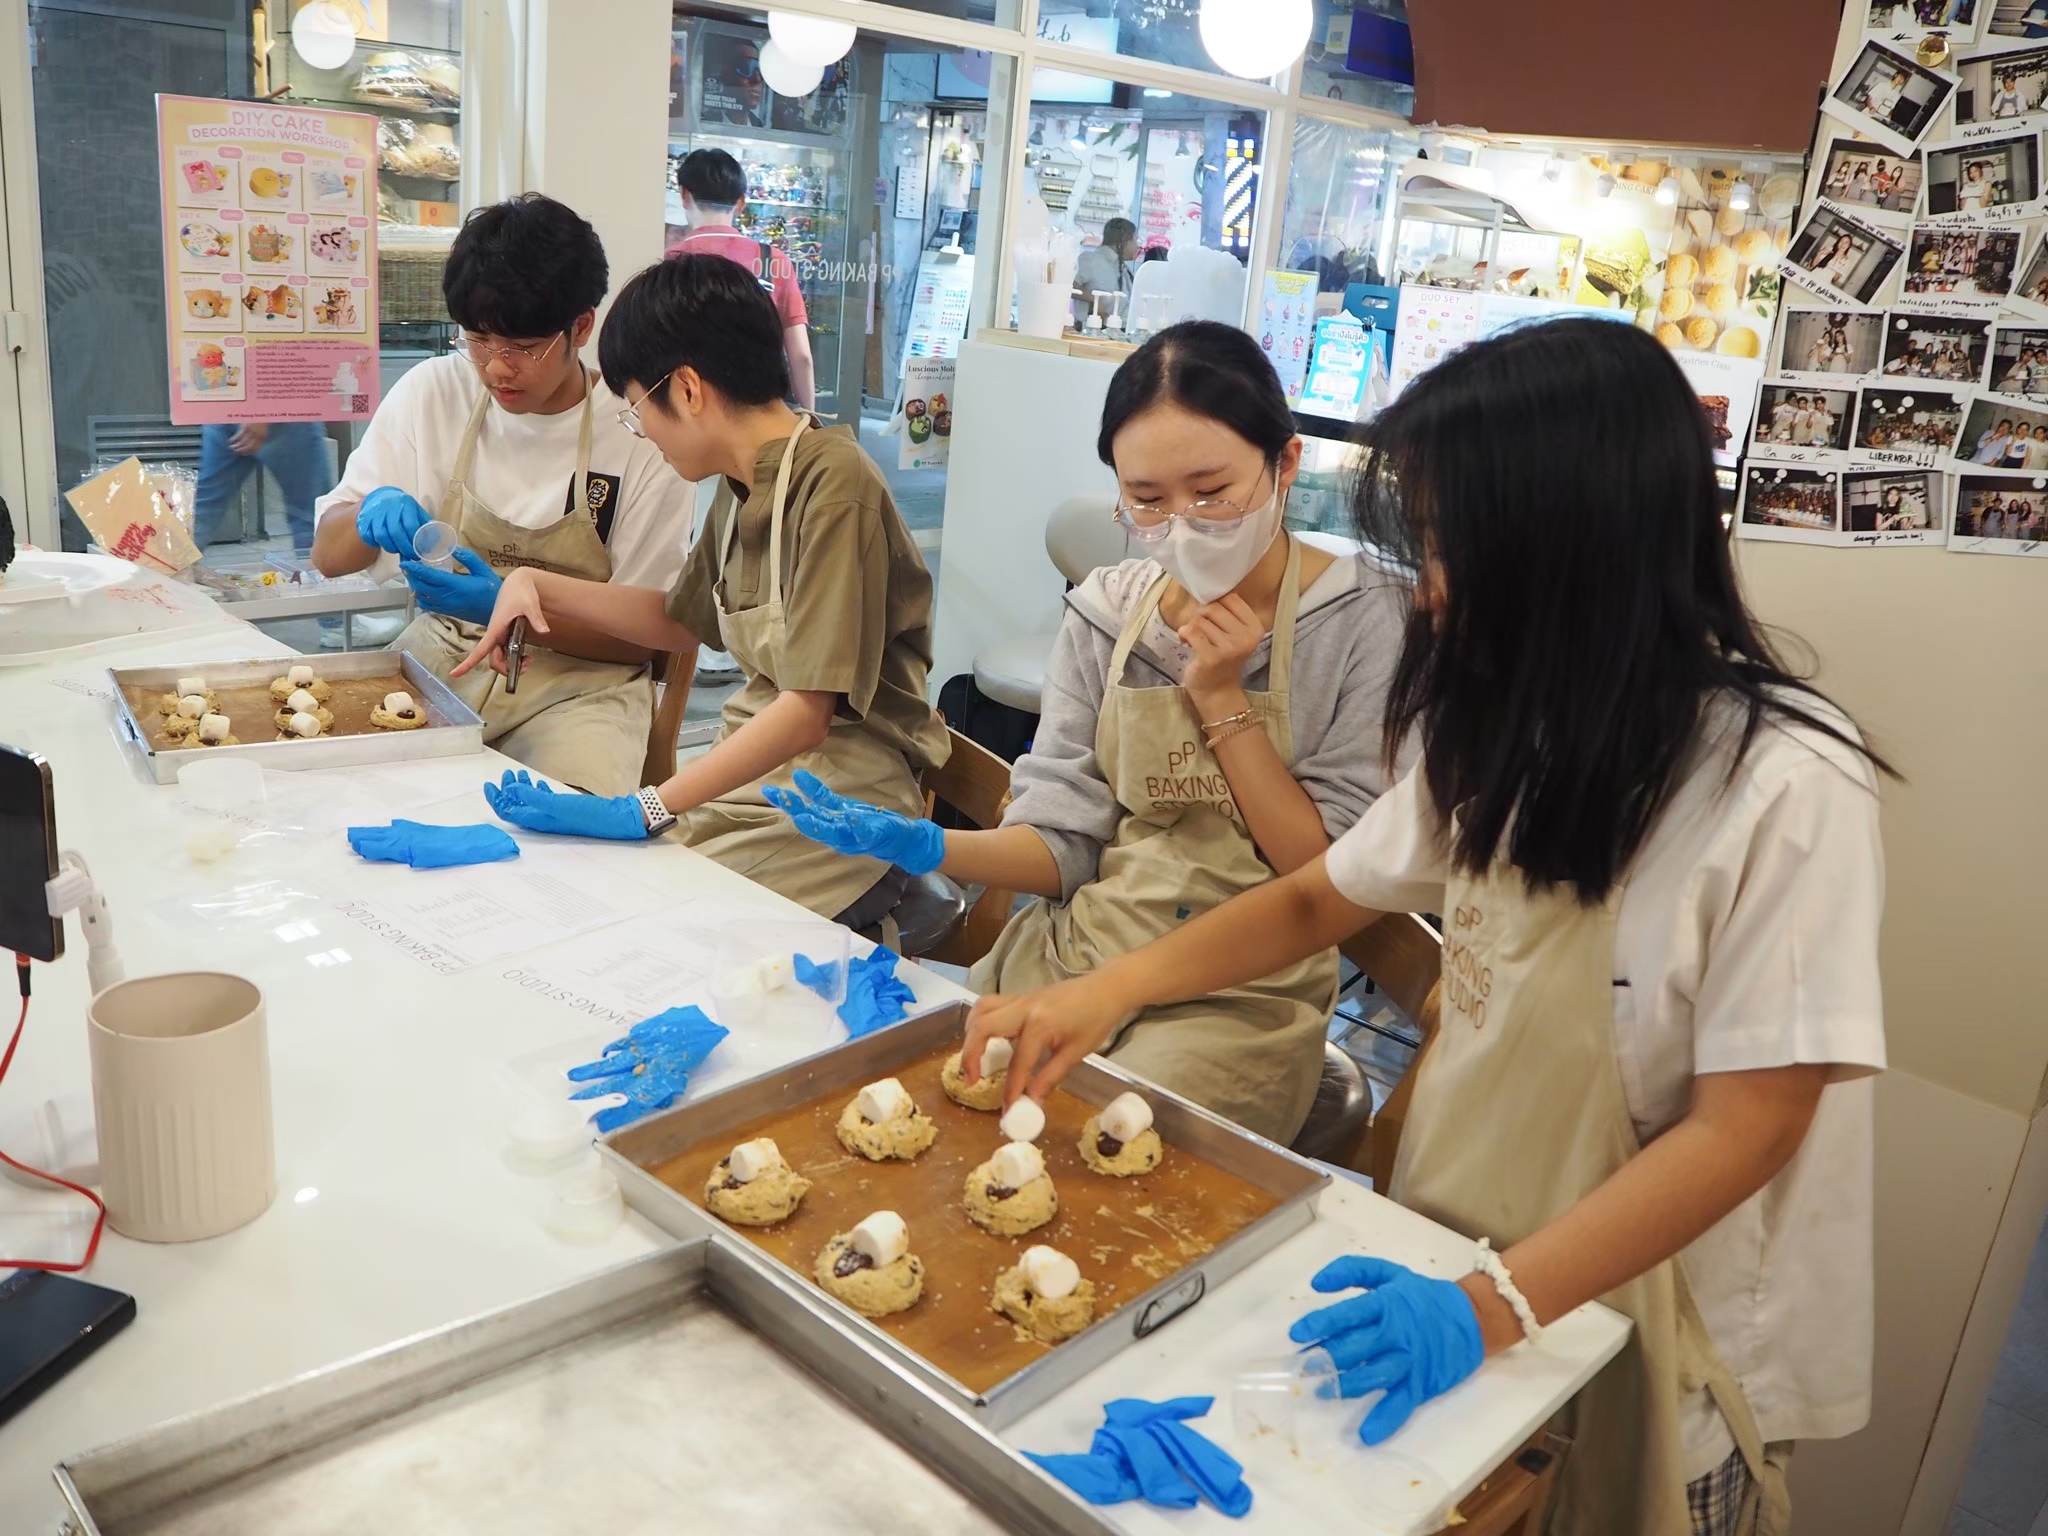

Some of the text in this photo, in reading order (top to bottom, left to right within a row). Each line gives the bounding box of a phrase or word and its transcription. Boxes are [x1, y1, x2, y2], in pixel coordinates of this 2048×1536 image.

[232, 111, 323, 133] DIY CAKE
[191, 126, 350, 149] DECORATION WORKSHOP
[1421, 293, 1461, 304] DUO SET
[908, 365, 940, 373] Luscious
[1678, 357, 1732, 371] Pastries Class
[1869, 452, 1914, 464] LIBERATOR
[1168, 741, 1197, 775] PP
[1145, 774, 1228, 799] BAKING
[1454, 906, 1483, 931] PP
[382, 929, 442, 961] BAKING
[502, 969, 574, 1001] STUDIO
[567, 996, 629, 1026] AKING
